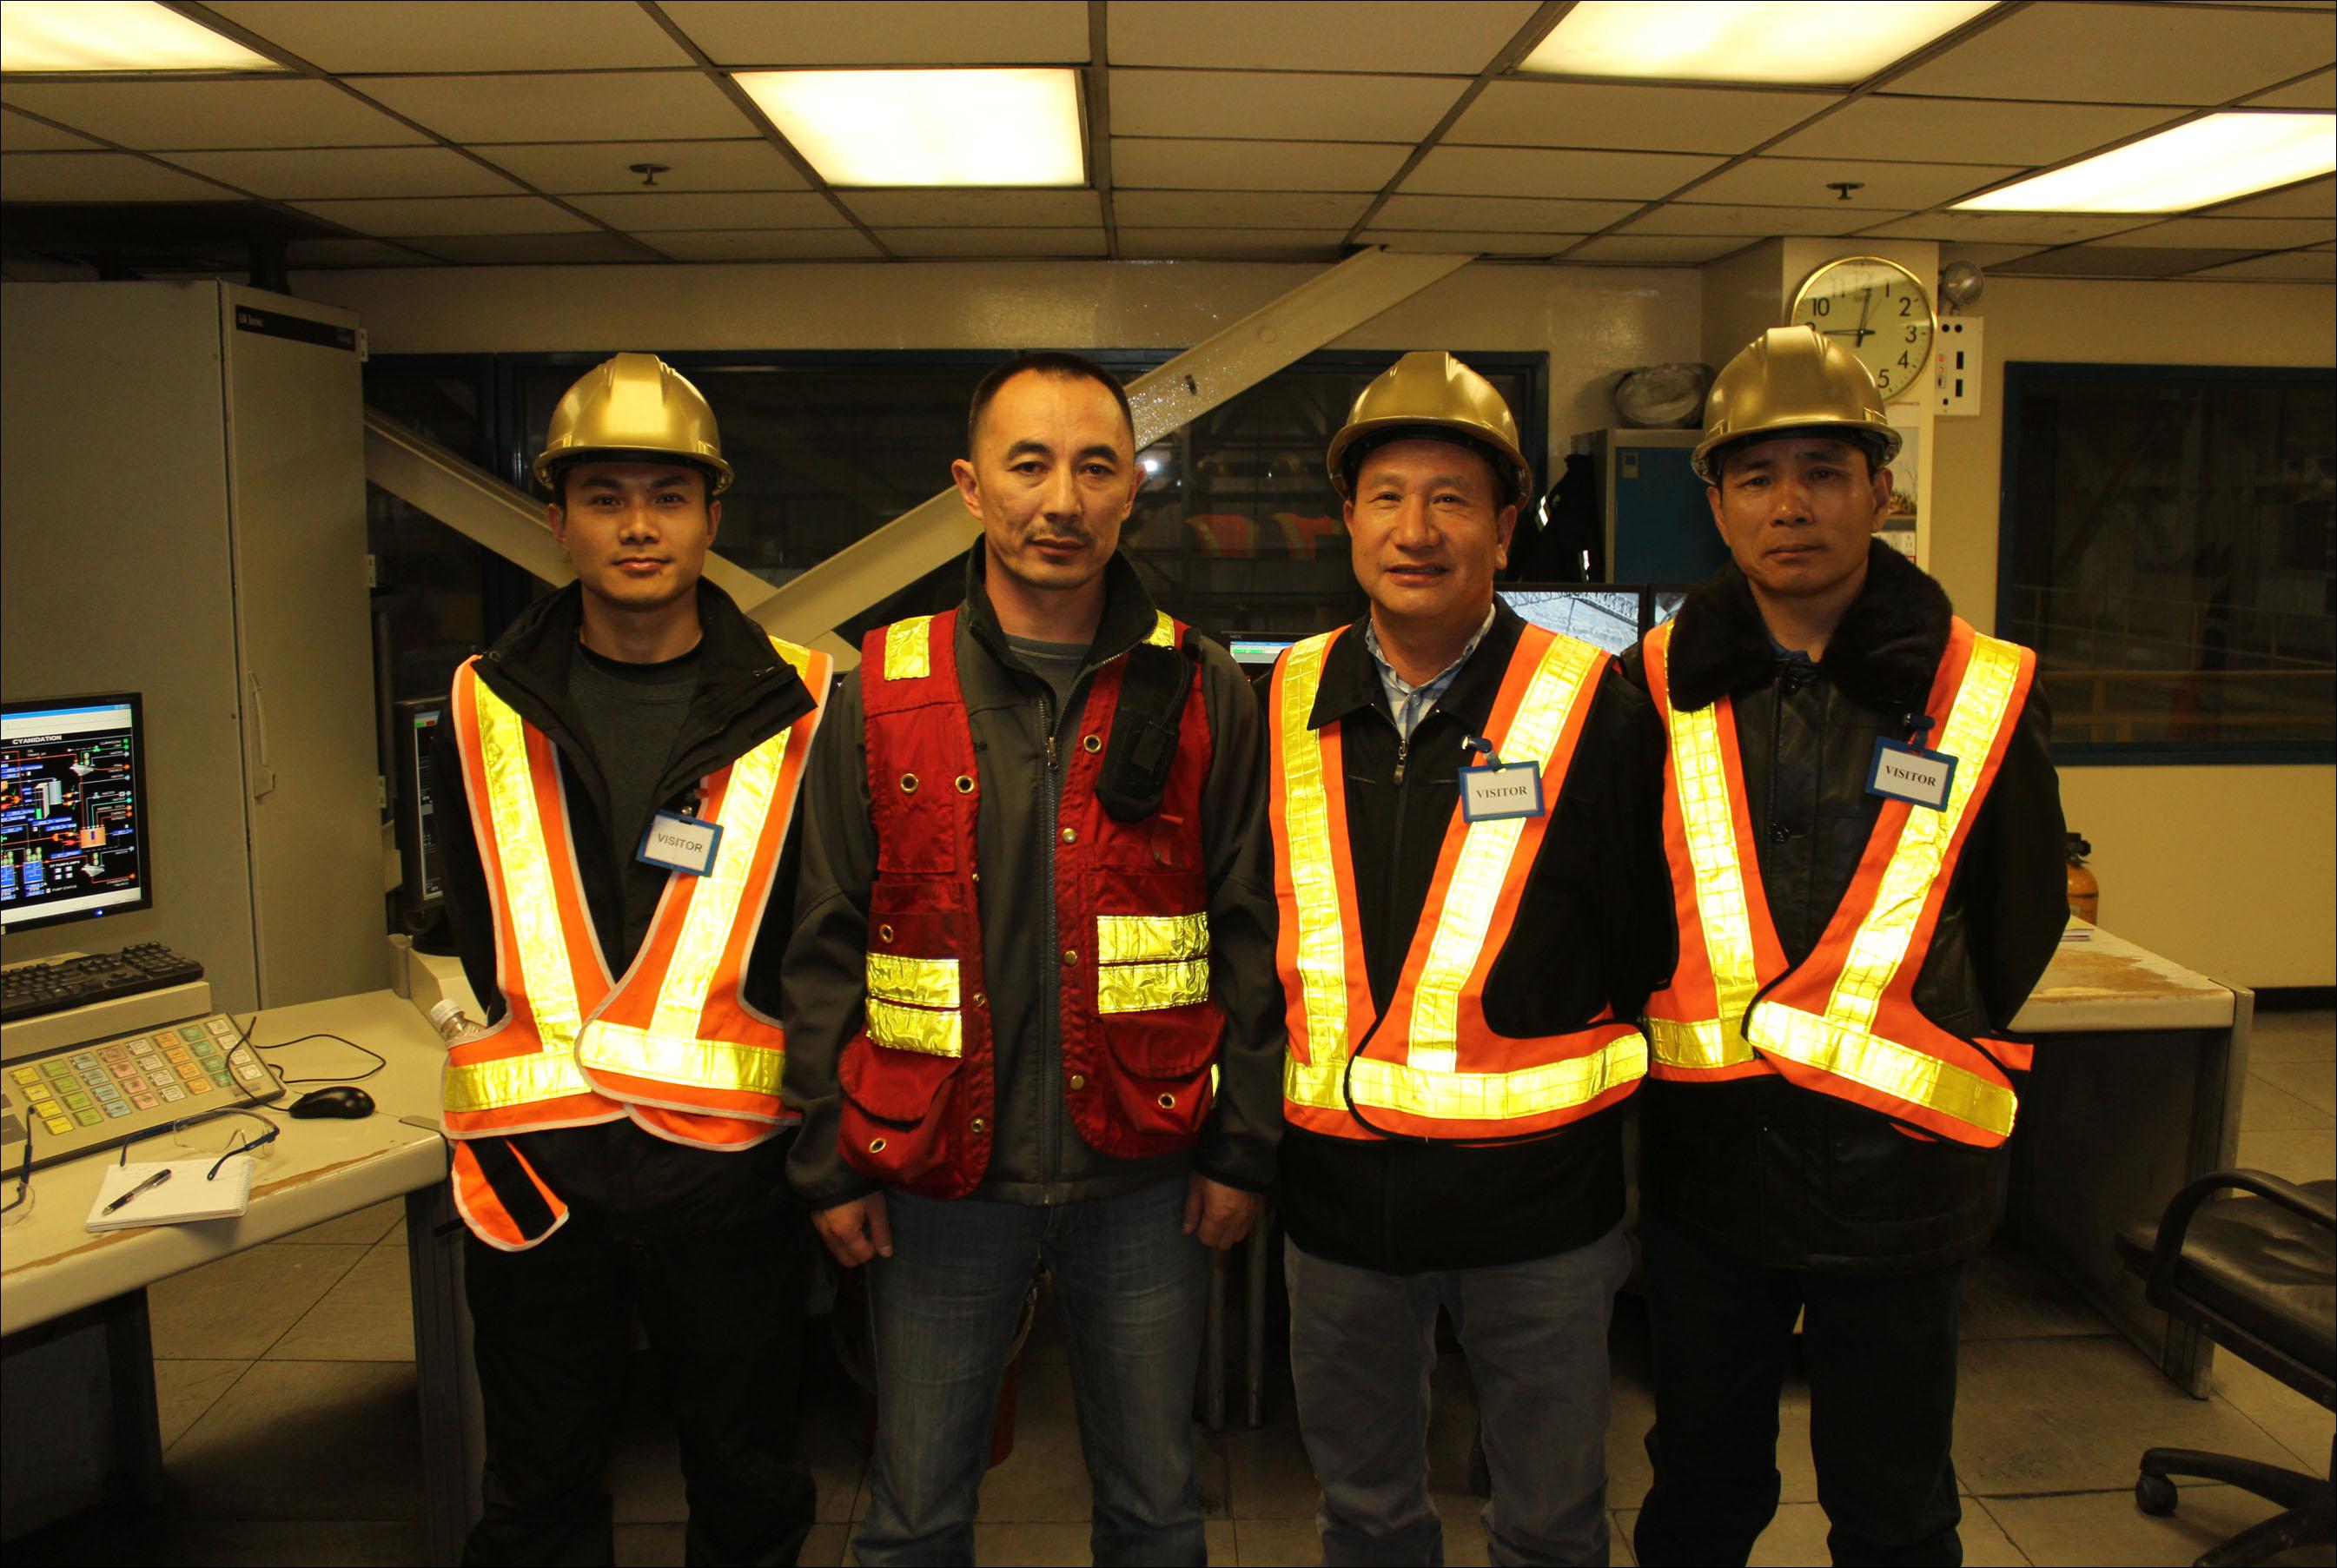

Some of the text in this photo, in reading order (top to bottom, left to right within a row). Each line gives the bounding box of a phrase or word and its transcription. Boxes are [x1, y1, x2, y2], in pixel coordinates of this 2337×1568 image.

[1884, 280, 1890, 298] 1
[1812, 297, 1831, 316] 10
[1899, 297, 1910, 316] 2
[1905, 325, 1917, 343] 3
[1897, 350, 1910, 369] 4
[1877, 369, 1890, 388] 5
[12, 735, 63, 744] CYANIDATION
[1886, 765, 1936, 786] VISITOR
[1476, 786, 1528, 798] VISITOR
[658, 833, 703, 853] VISITOR
